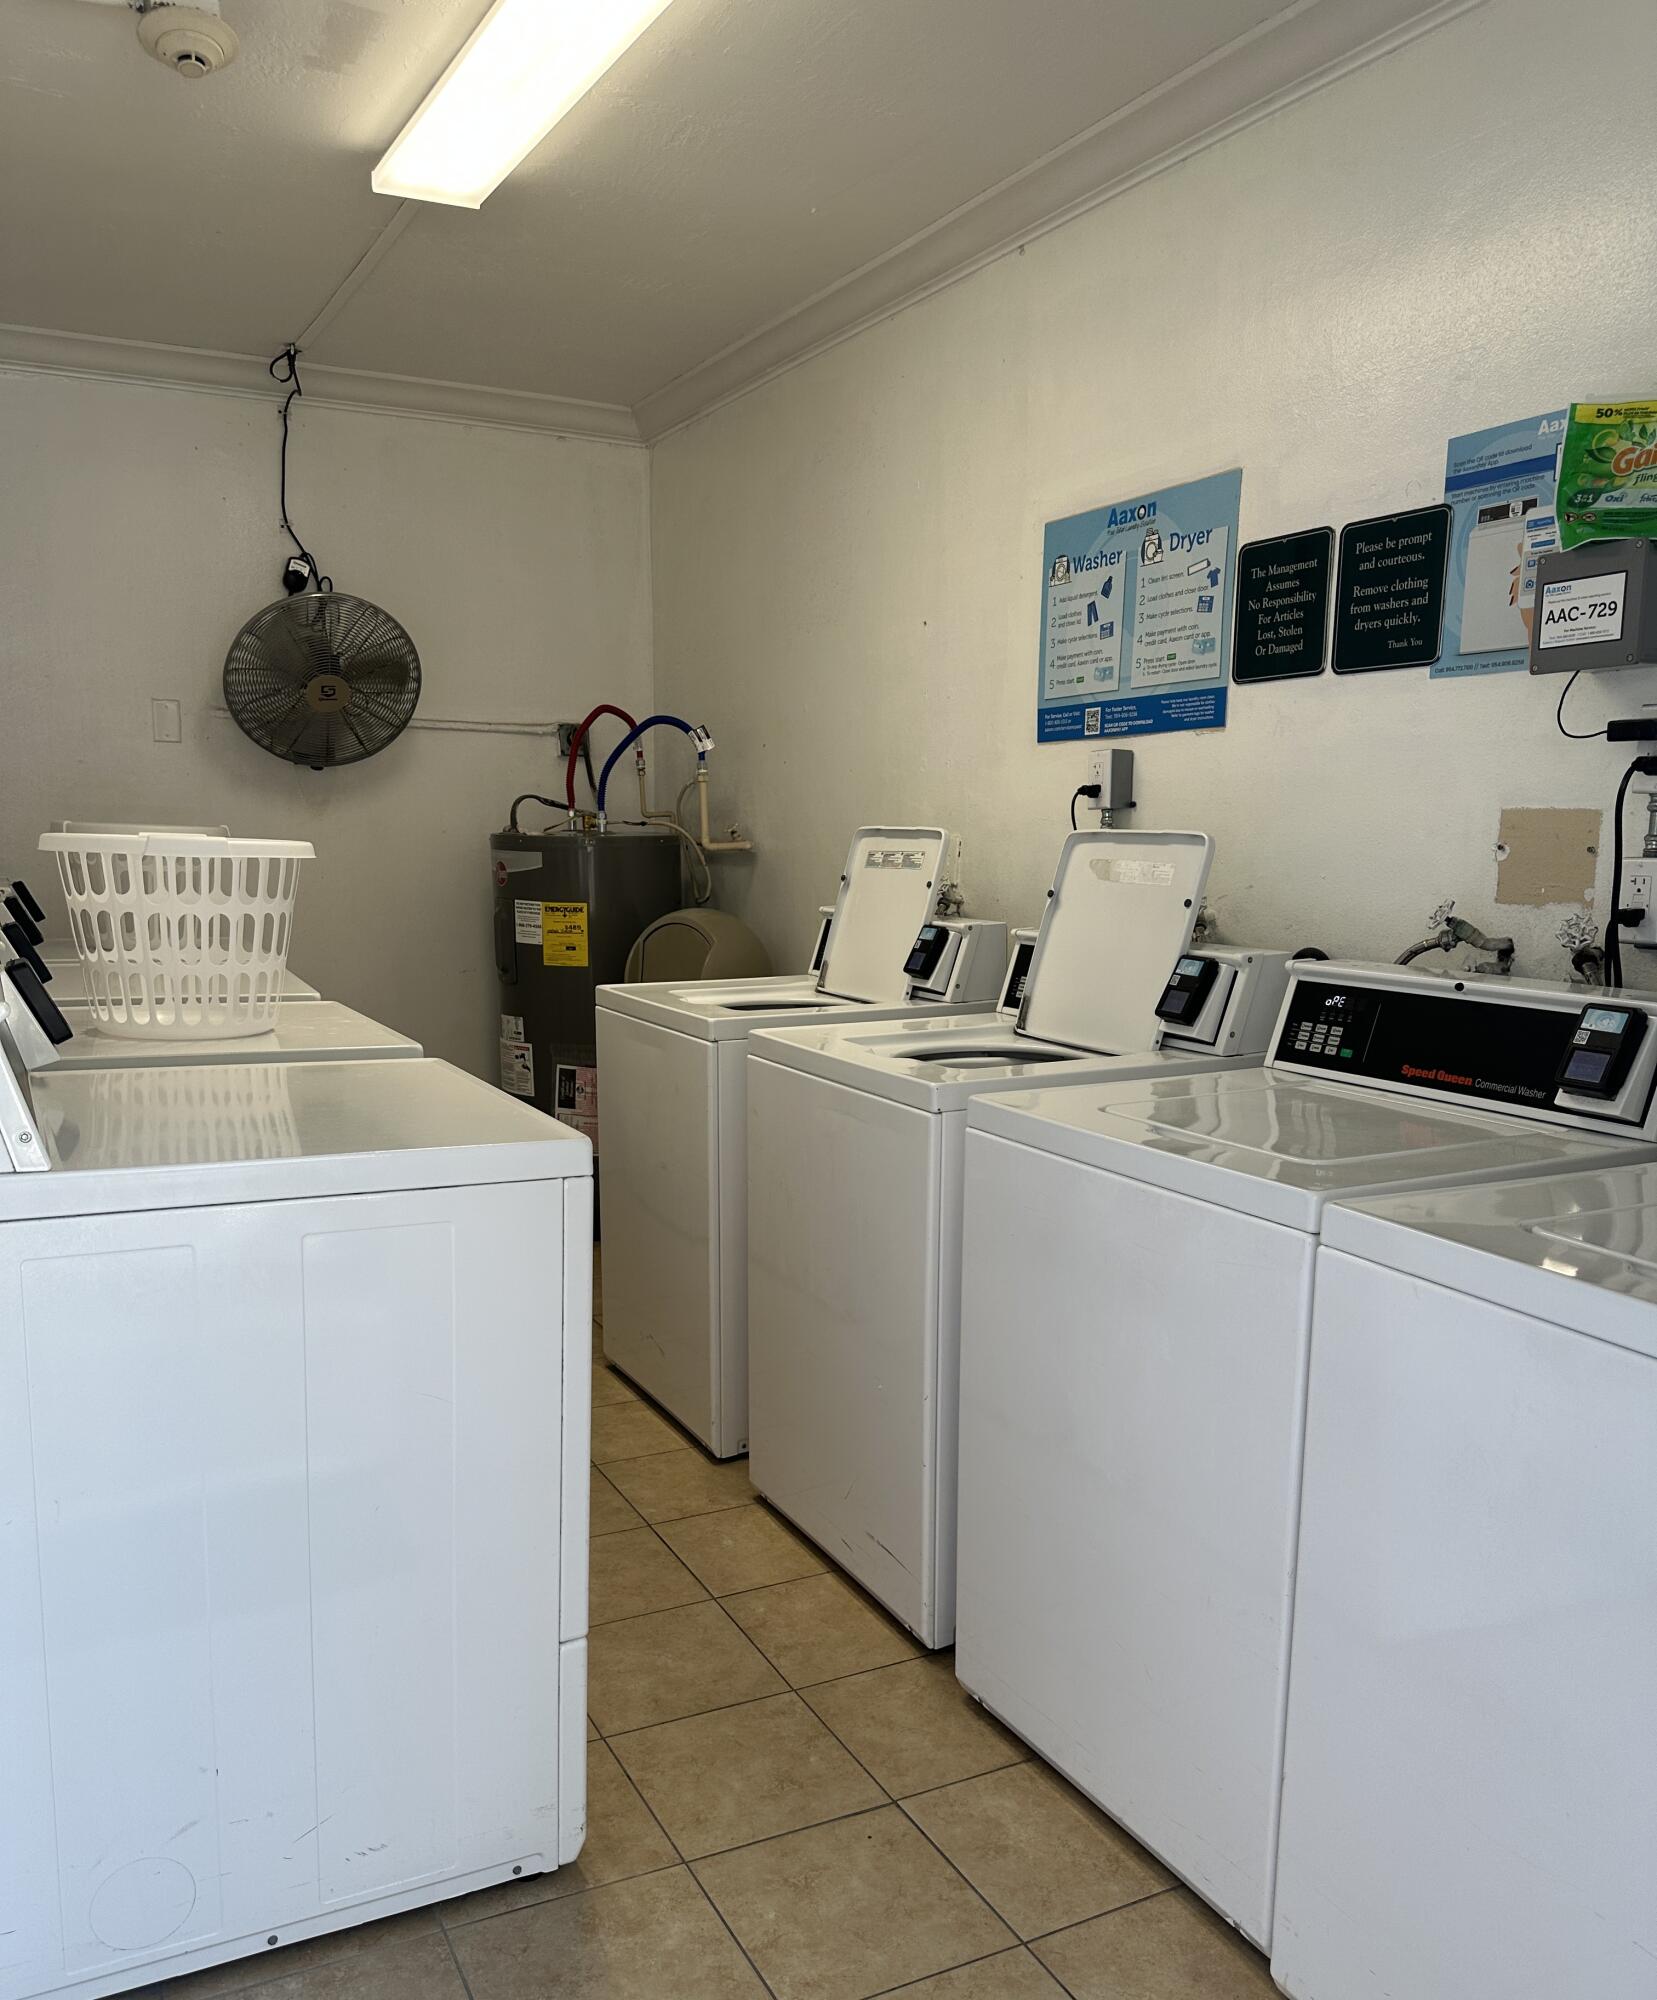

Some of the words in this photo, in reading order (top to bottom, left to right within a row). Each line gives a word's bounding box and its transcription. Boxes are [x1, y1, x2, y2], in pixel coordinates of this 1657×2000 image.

[1596, 408, 1623, 418] 50%
[1505, 444, 1532, 456] download
[1497, 479, 1519, 490] entering
[1451, 497, 1471, 505] number
[1107, 502, 1157, 528] Aaxon
[1170, 528, 1212, 552] Dryer
[1355, 541, 1384, 555] Please
[1386, 538, 1396, 549] be
[1398, 532, 1432, 550] prompt
[1073, 550, 1123, 574] Washer
[1251, 567, 1266, 579] The
[1268, 558, 1318, 576] Management
[1359, 559, 1376, 571] and
[1378, 552, 1425, 568] courteous.
[1265, 578, 1300, 592] Assumes
[1353, 582, 1389, 598] Remove
[1391, 577, 1429, 594] clothing
[1545, 585, 1572, 594] Aaxon
[1139, 594, 1145, 606] 2
[1147, 594, 1157, 602] Load
[1158, 590, 1173, 599] clothes
[1184, 586, 1196, 594] close
[1248, 599, 1261, 611] No
[1263, 590, 1317, 609] Responsibility
[1350, 601, 1371, 615] from
[1373, 598, 1409, 611] washers
[1411, 594, 1429, 606] and
[1138, 612, 1144, 623] 3
[1146, 612, 1157, 621] Make
[1158, 609, 1169, 619] cycle
[1258, 613, 1272, 624] For
[1274, 609, 1304, 623] Articles
[1545, 601, 1617, 624] AAC-729
[1051, 617, 1056, 627] 2
[1354, 618, 1382, 632] dryers
[1384, 612, 1421, 630] quickly.
[1137, 634, 1142, 645] 4
[1145, 630, 1156, 639] Make
[1156, 626, 1176, 637] payment
[1177, 624, 1187, 634] with
[1257, 628, 1277, 640] Lost,
[1279, 625, 1303, 637] Stolen
[1050, 638, 1055, 648] 3
[1255, 646, 1266, 656] Or
[1268, 641, 1303, 655] Damaged
[1387, 639, 1408, 649] Thank
[1410, 637, 1423, 648] You
[1049, 659, 1055, 669] 4
[1135, 658, 1141, 668] 5
[1049, 679, 1054, 689] 5
[1401, 1064, 1436, 1080] Speed
[1437, 1070, 1473, 1086] Queen
[1475, 1078, 1517, 1094] Commercial
[1518, 1085, 1546, 1099] Washer
